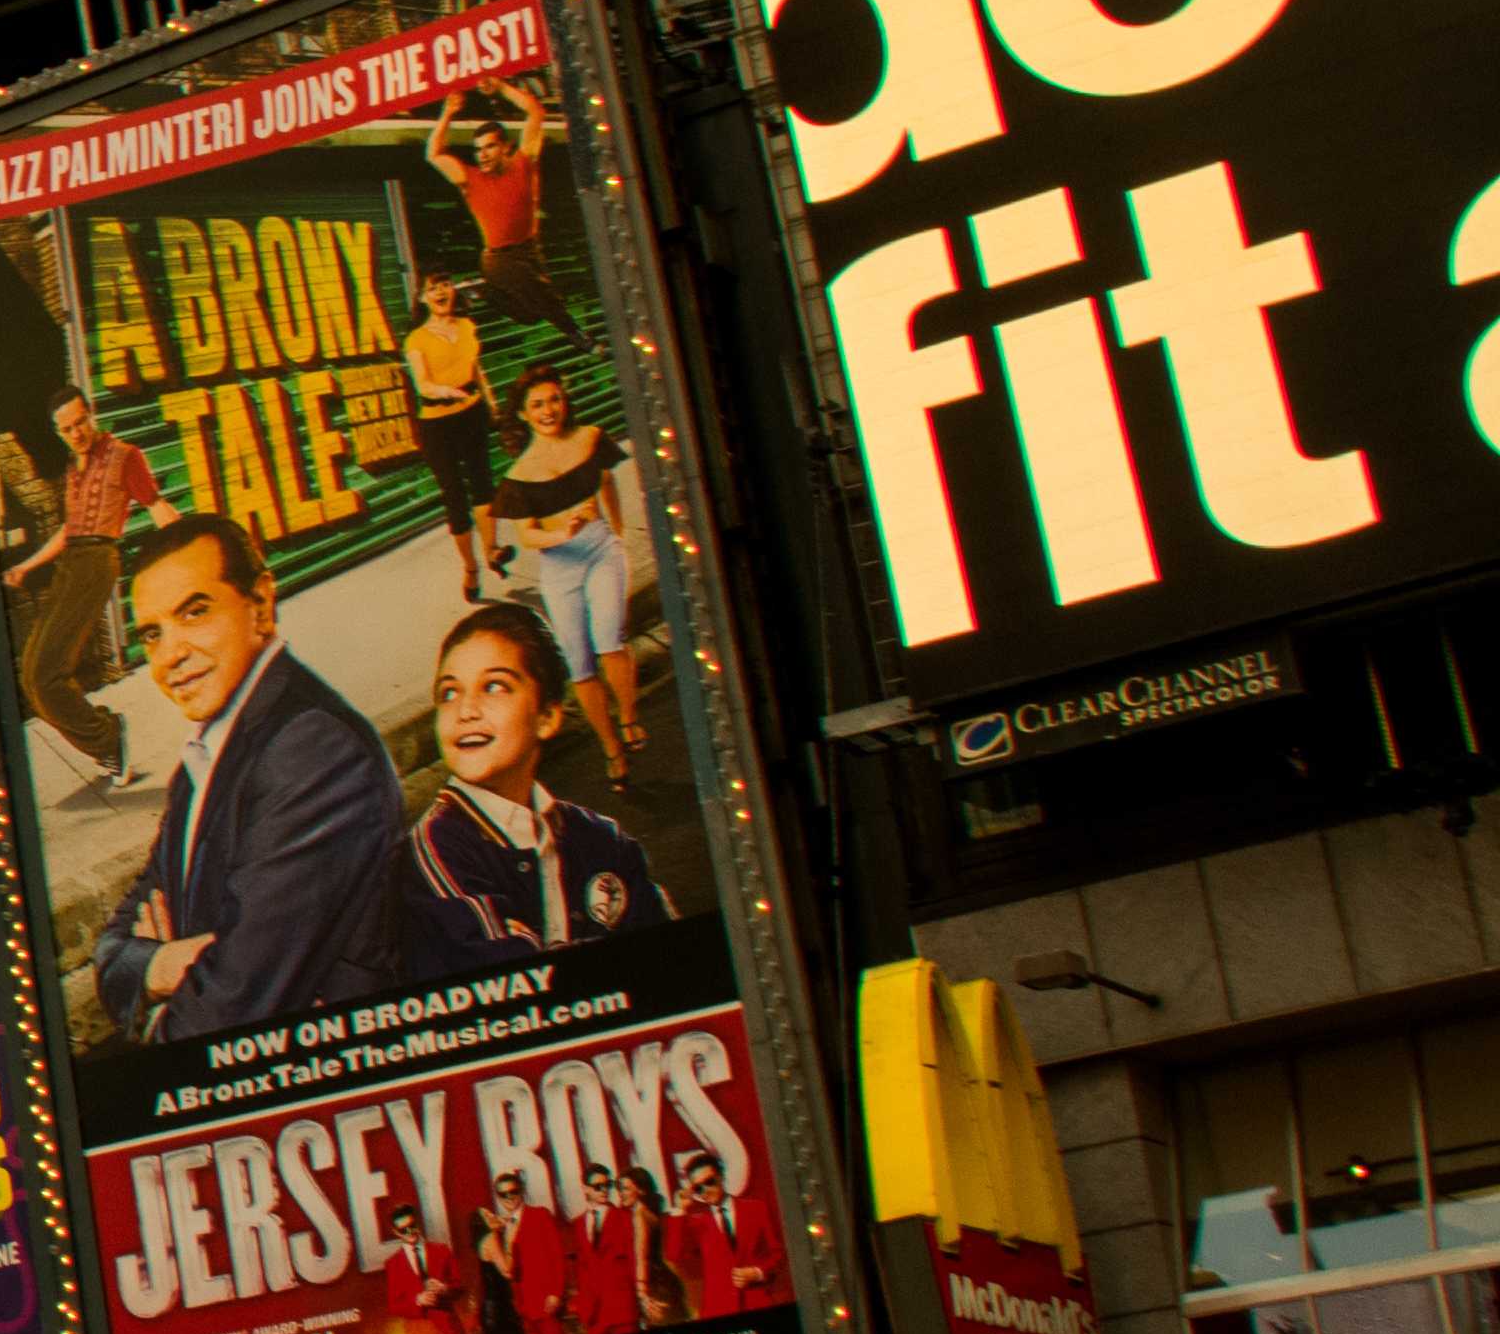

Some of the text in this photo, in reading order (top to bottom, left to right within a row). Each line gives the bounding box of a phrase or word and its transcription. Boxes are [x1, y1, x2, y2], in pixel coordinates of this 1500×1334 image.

[49, 97, 247, 193] PALMINTERI
[252, 66, 356, 140] JOINS
[359, 40, 425, 99] THE
[431, 5, 538, 84] CAST!
[89, 215, 396, 391] A BRONX
[159, 369, 367, 541] TALE
[824, 158, 1380, 647] fit
[1120, 675, 1281, 727] SPECTACOLOR
[154, 987, 631, 1118] ABronxTaleTheMusical.com
[209, 966, 556, 1069] NOW ON BROADWAY
[115, 1030, 751, 1320] JERSEY BOYS
